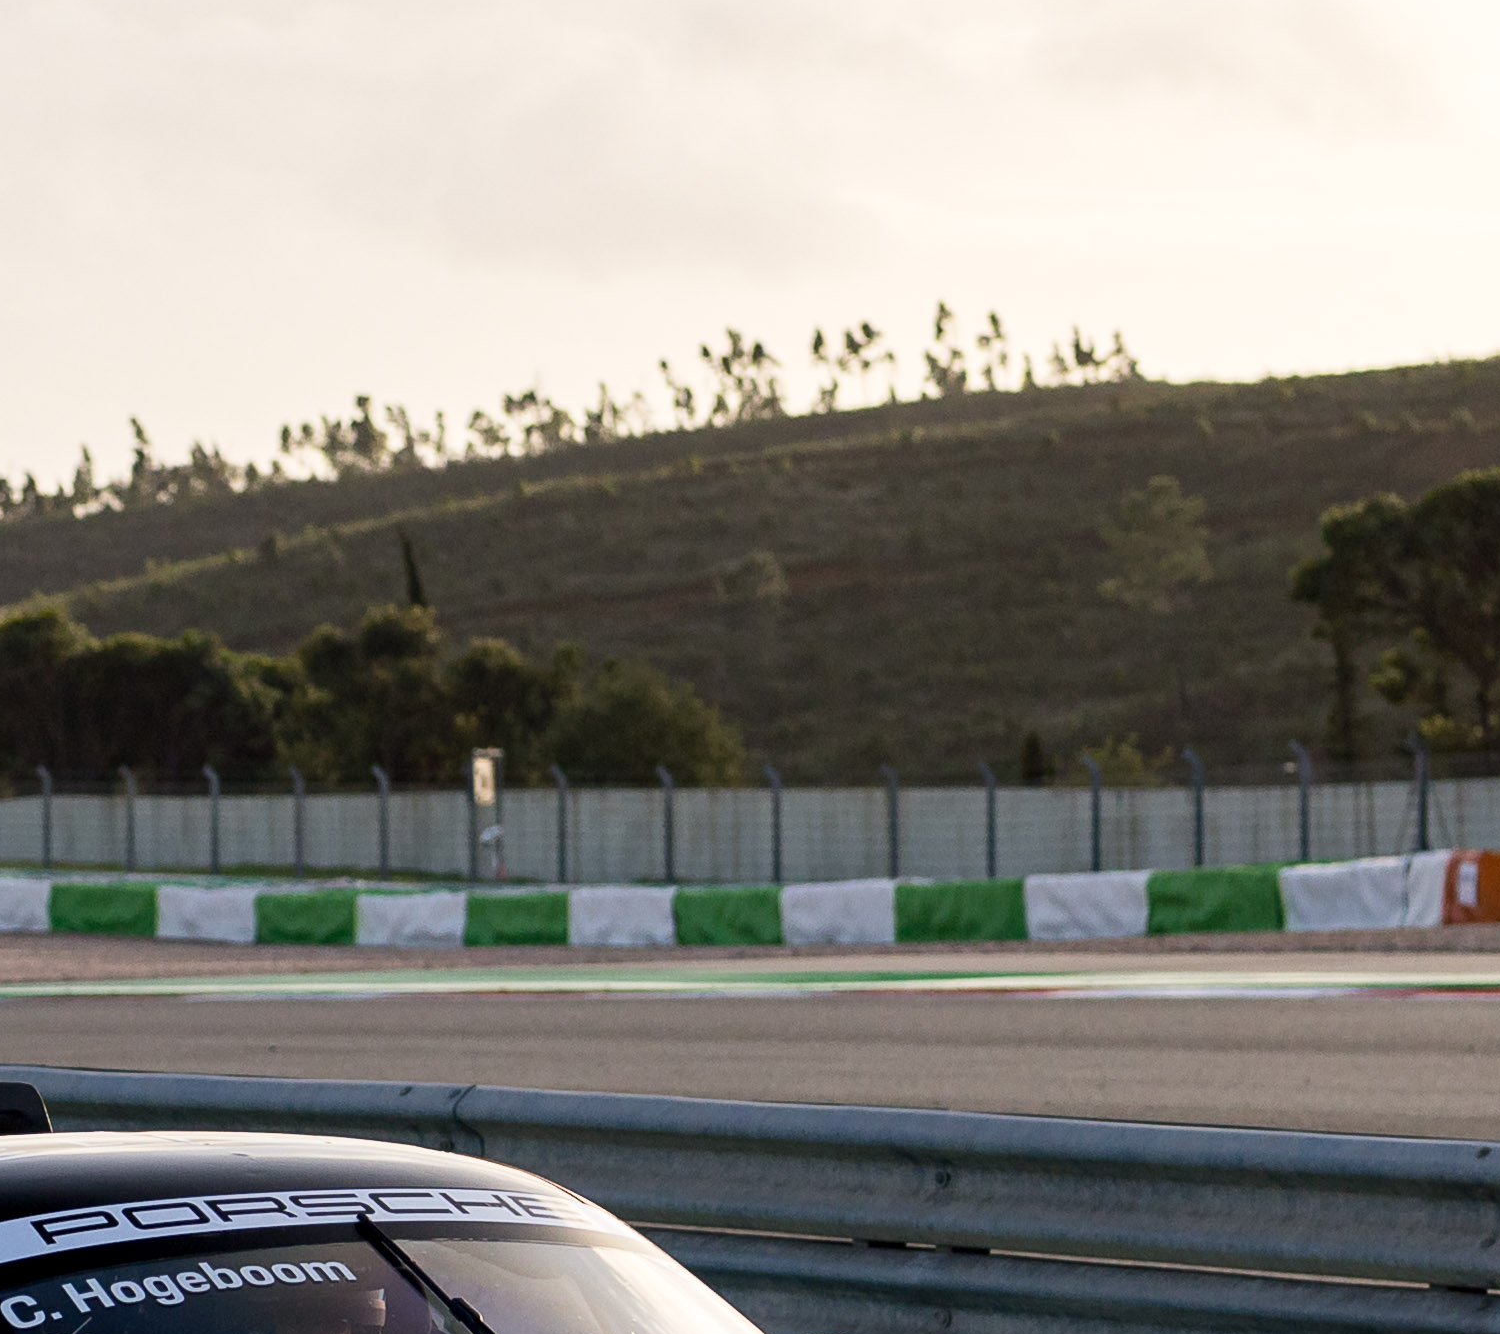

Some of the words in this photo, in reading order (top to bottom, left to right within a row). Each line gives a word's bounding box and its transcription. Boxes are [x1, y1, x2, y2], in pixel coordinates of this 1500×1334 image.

[31, 1192, 590, 1245] PORSCHE
[0, 1294, 61, 1330] C.
[62, 1258, 357, 1305] Hogeboom
